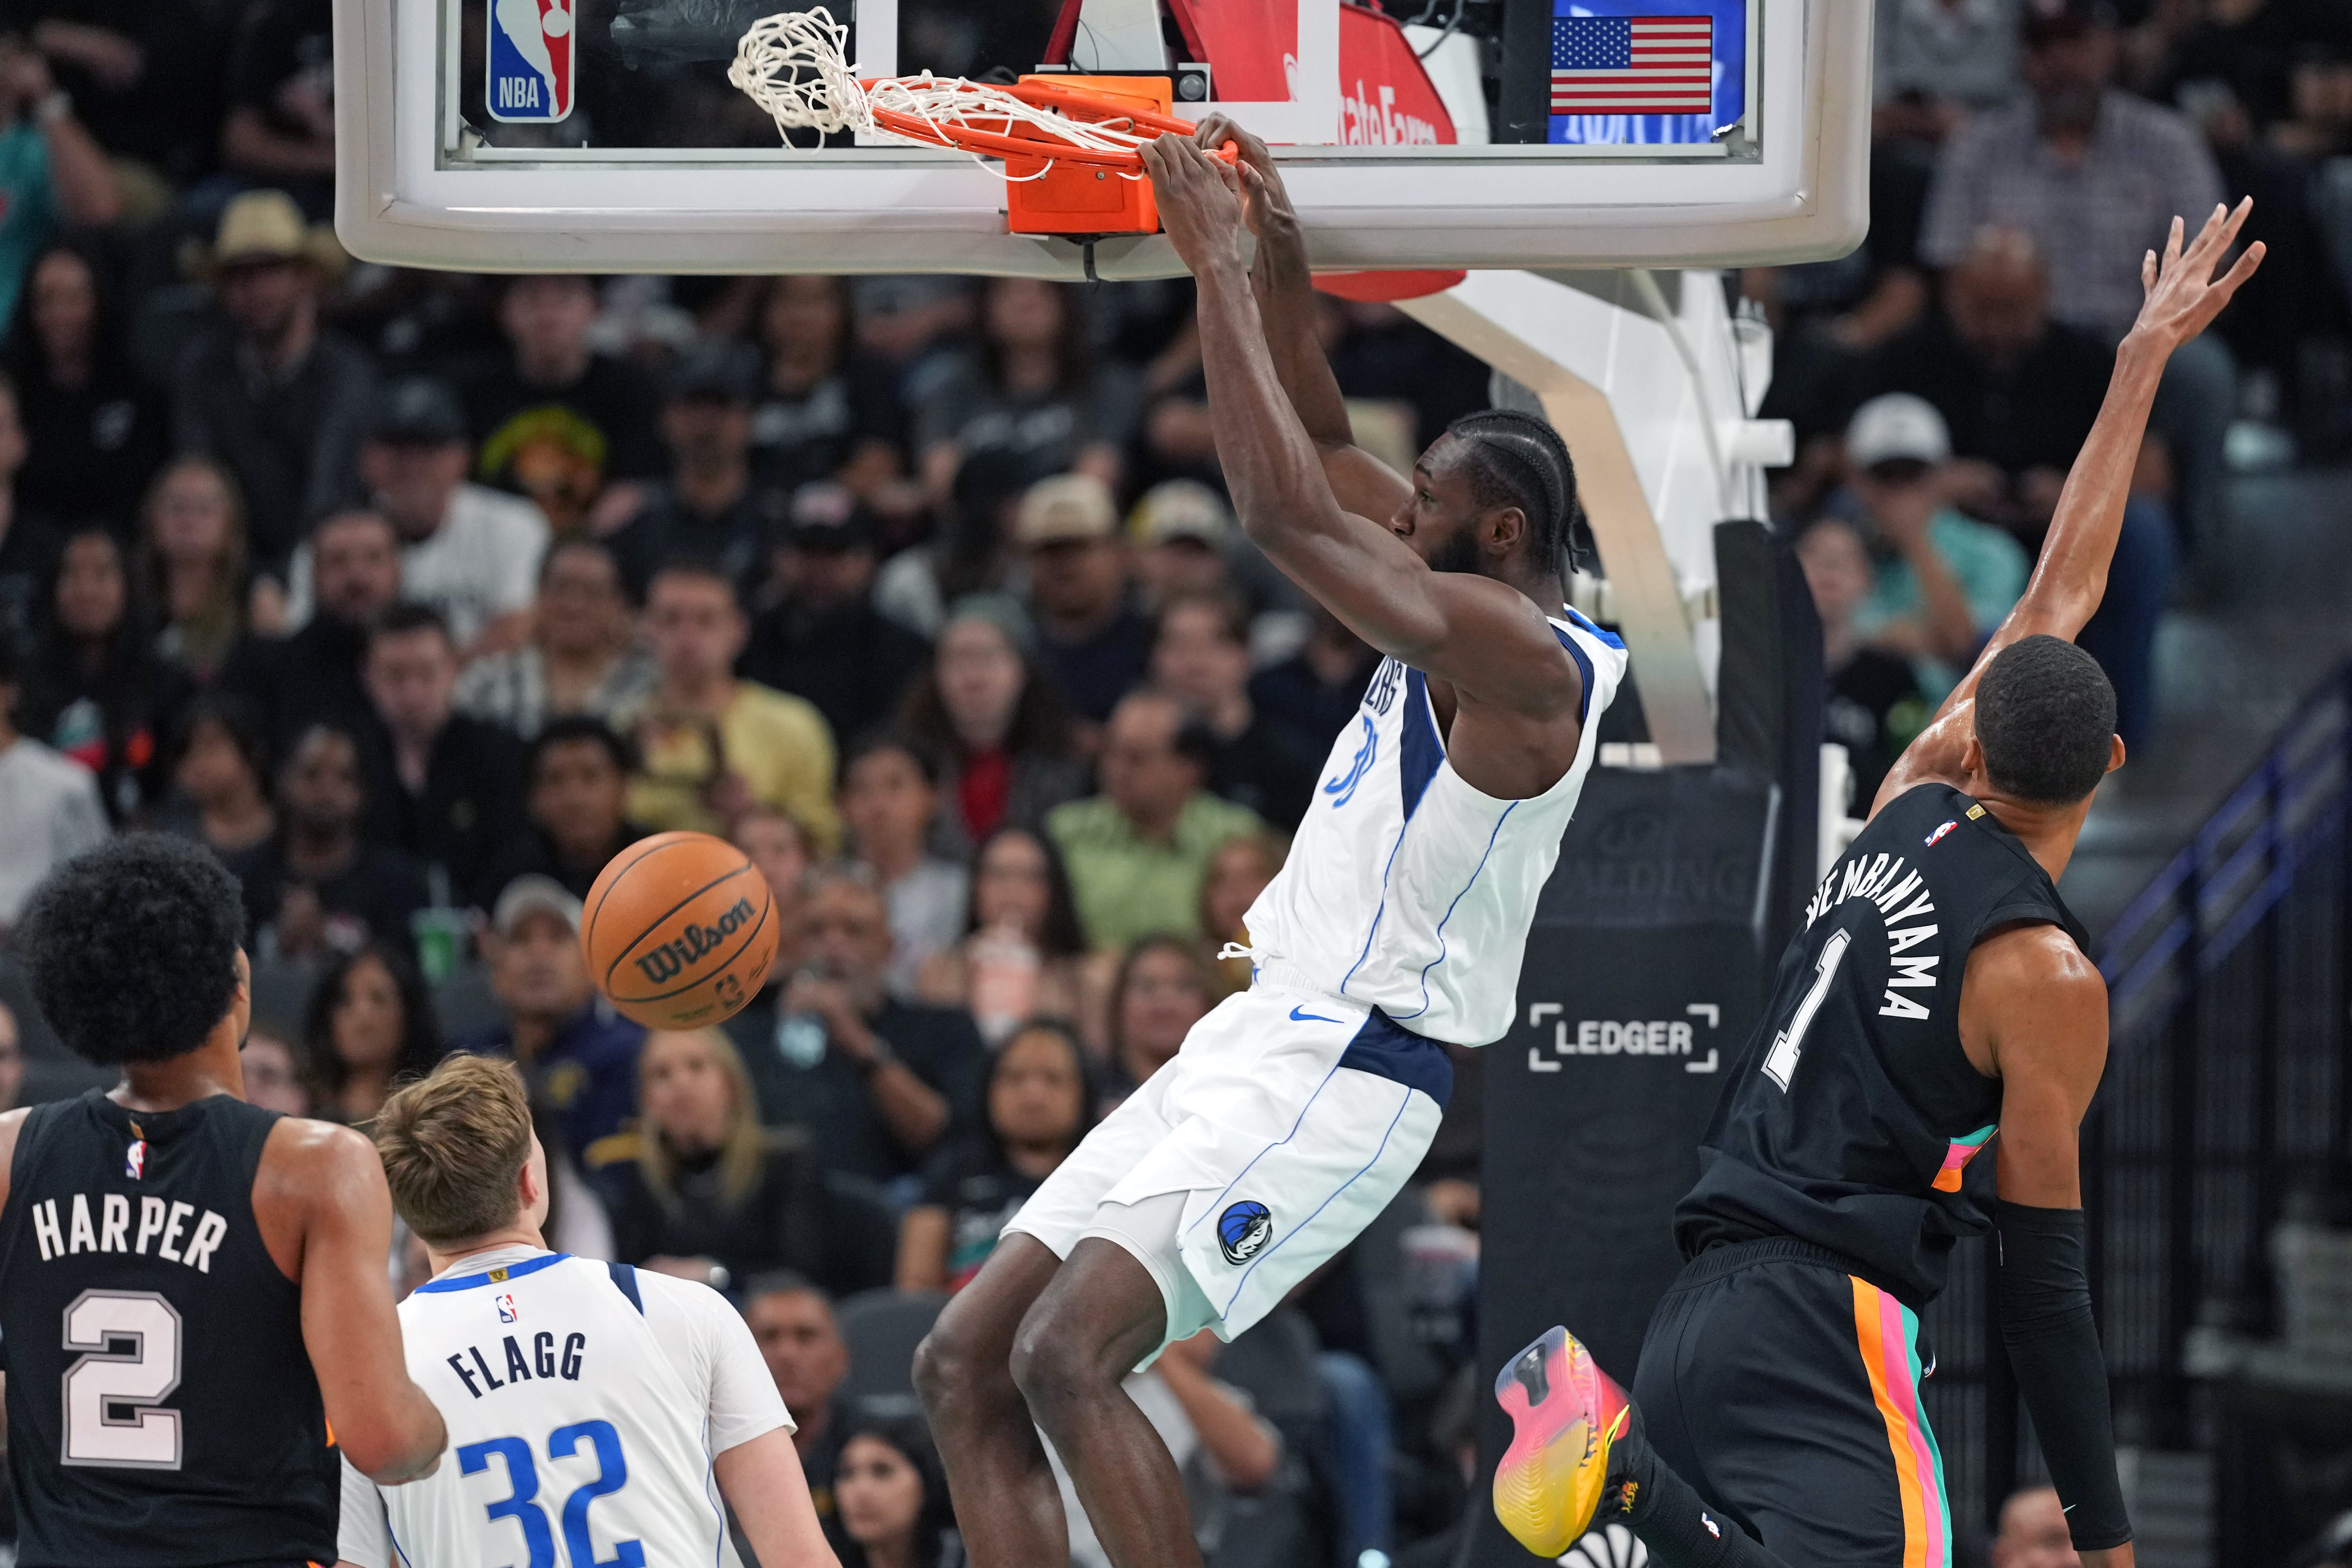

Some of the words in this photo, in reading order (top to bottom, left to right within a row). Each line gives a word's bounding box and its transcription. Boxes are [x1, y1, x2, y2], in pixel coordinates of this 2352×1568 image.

[499, 76, 540, 108] NBA
[634, 896, 755, 984] Wilson
[1805, 853, 1940, 1020] WEMBANYAMA
[1555, 1020, 1693, 1055] LEDGER
[1760, 927, 1851, 1094] 1
[32, 1193, 228, 1274] HARPER
[60, 1288, 183, 1471] 2
[446, 1332, 586, 1399] FLAGG
[453, 1417, 646, 1568] 32
